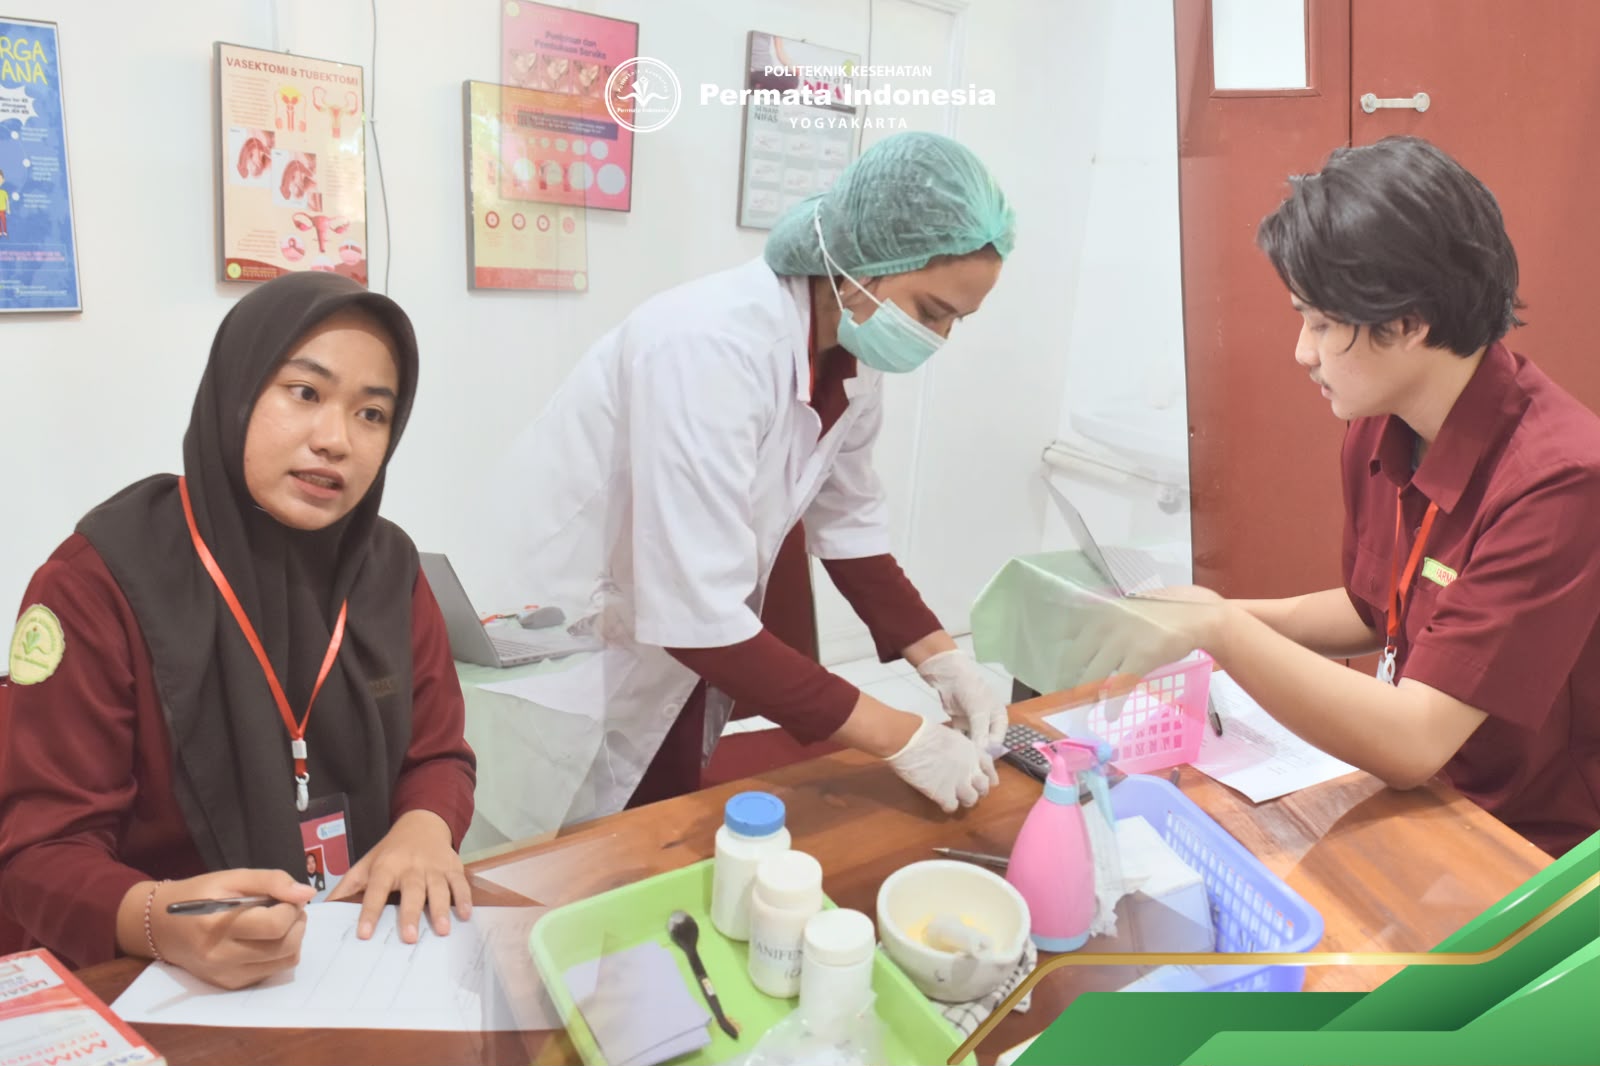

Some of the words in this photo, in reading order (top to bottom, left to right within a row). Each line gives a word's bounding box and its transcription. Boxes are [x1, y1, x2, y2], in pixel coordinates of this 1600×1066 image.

[0, 35, 48, 64] RGA
[1, 58, 48, 86] ANA
[226, 56, 289, 75] VASEKTOMI
[299, 68, 359, 85] TUBEKTOMI
